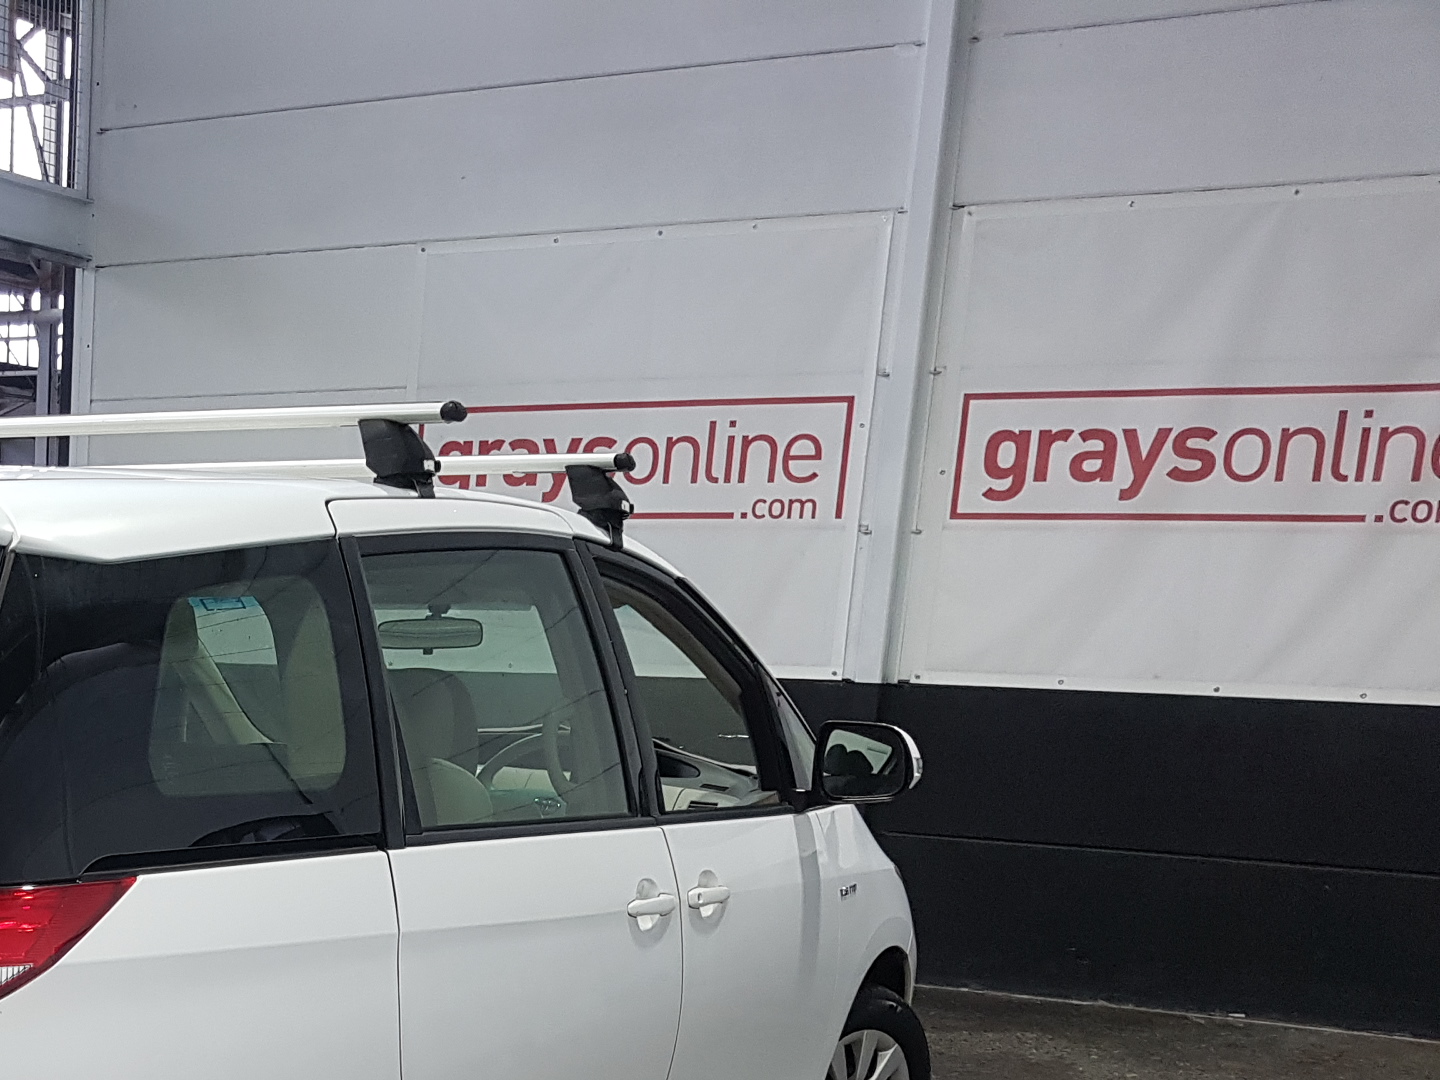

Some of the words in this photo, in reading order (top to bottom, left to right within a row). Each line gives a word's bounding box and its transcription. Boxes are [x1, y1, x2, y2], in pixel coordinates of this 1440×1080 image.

[981, 409, 1440, 502] graysonlin
[740, 497, 818, 520] .com
[1373, 499, 1440, 523] .co
